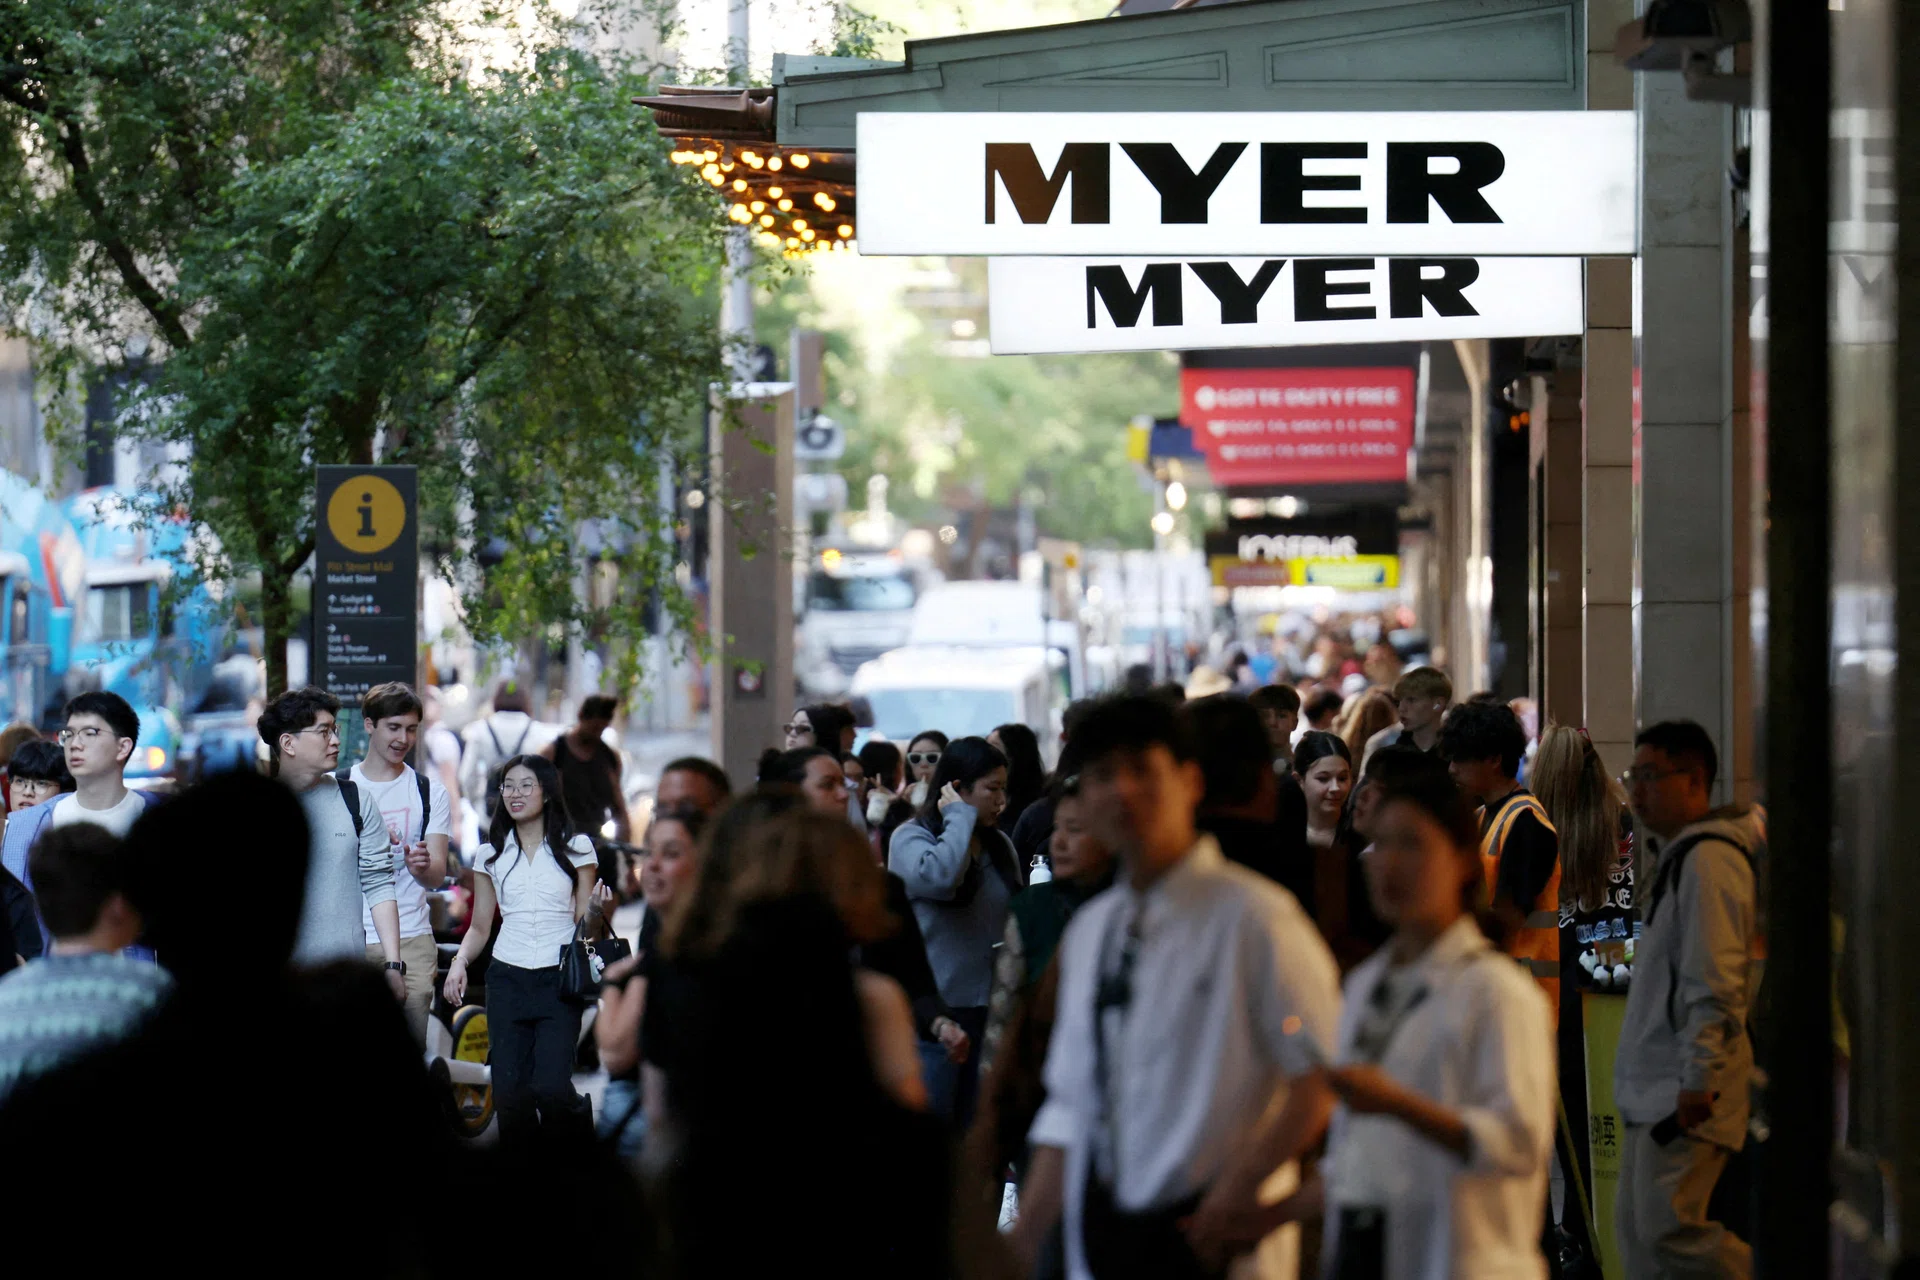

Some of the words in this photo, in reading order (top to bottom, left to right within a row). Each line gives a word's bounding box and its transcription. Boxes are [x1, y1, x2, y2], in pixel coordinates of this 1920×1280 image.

[984, 142, 1506, 225] MYER
[1086, 257, 1481, 329] MYER
[327, 574, 354, 585] Market
[355, 574, 377, 585] Street
